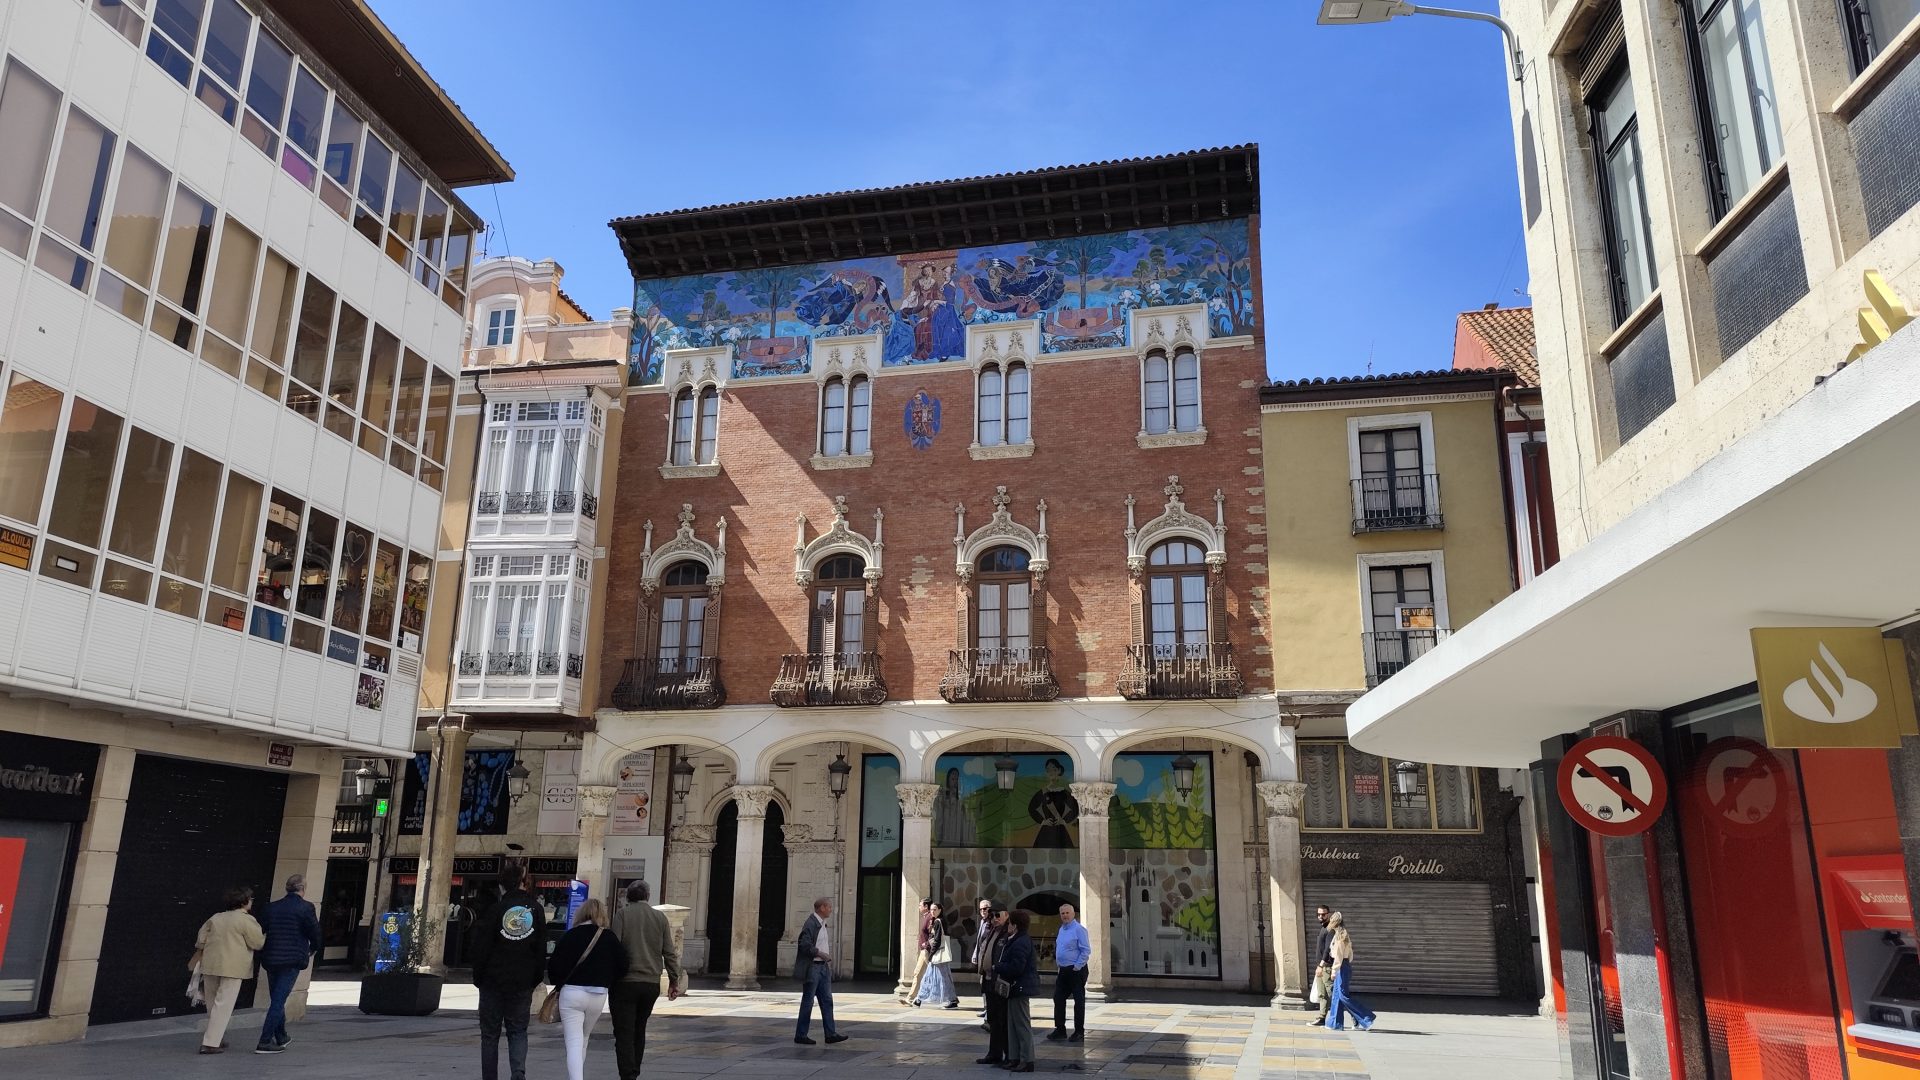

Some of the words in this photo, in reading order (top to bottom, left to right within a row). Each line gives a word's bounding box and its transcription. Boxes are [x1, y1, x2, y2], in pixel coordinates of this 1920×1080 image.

[1, 530, 31, 548] ALQUILA
[1412, 608, 1434, 616] VENDE
[0, 764, 85, 796] ccident
[622, 848, 633, 856] 38
[395, 861, 417, 871] CAL
[453, 861, 476, 871] YOR
[480, 860, 493, 871] 38
[534, 860, 577, 871] JOYERI
[1388, 855, 1445, 875] Portillo
